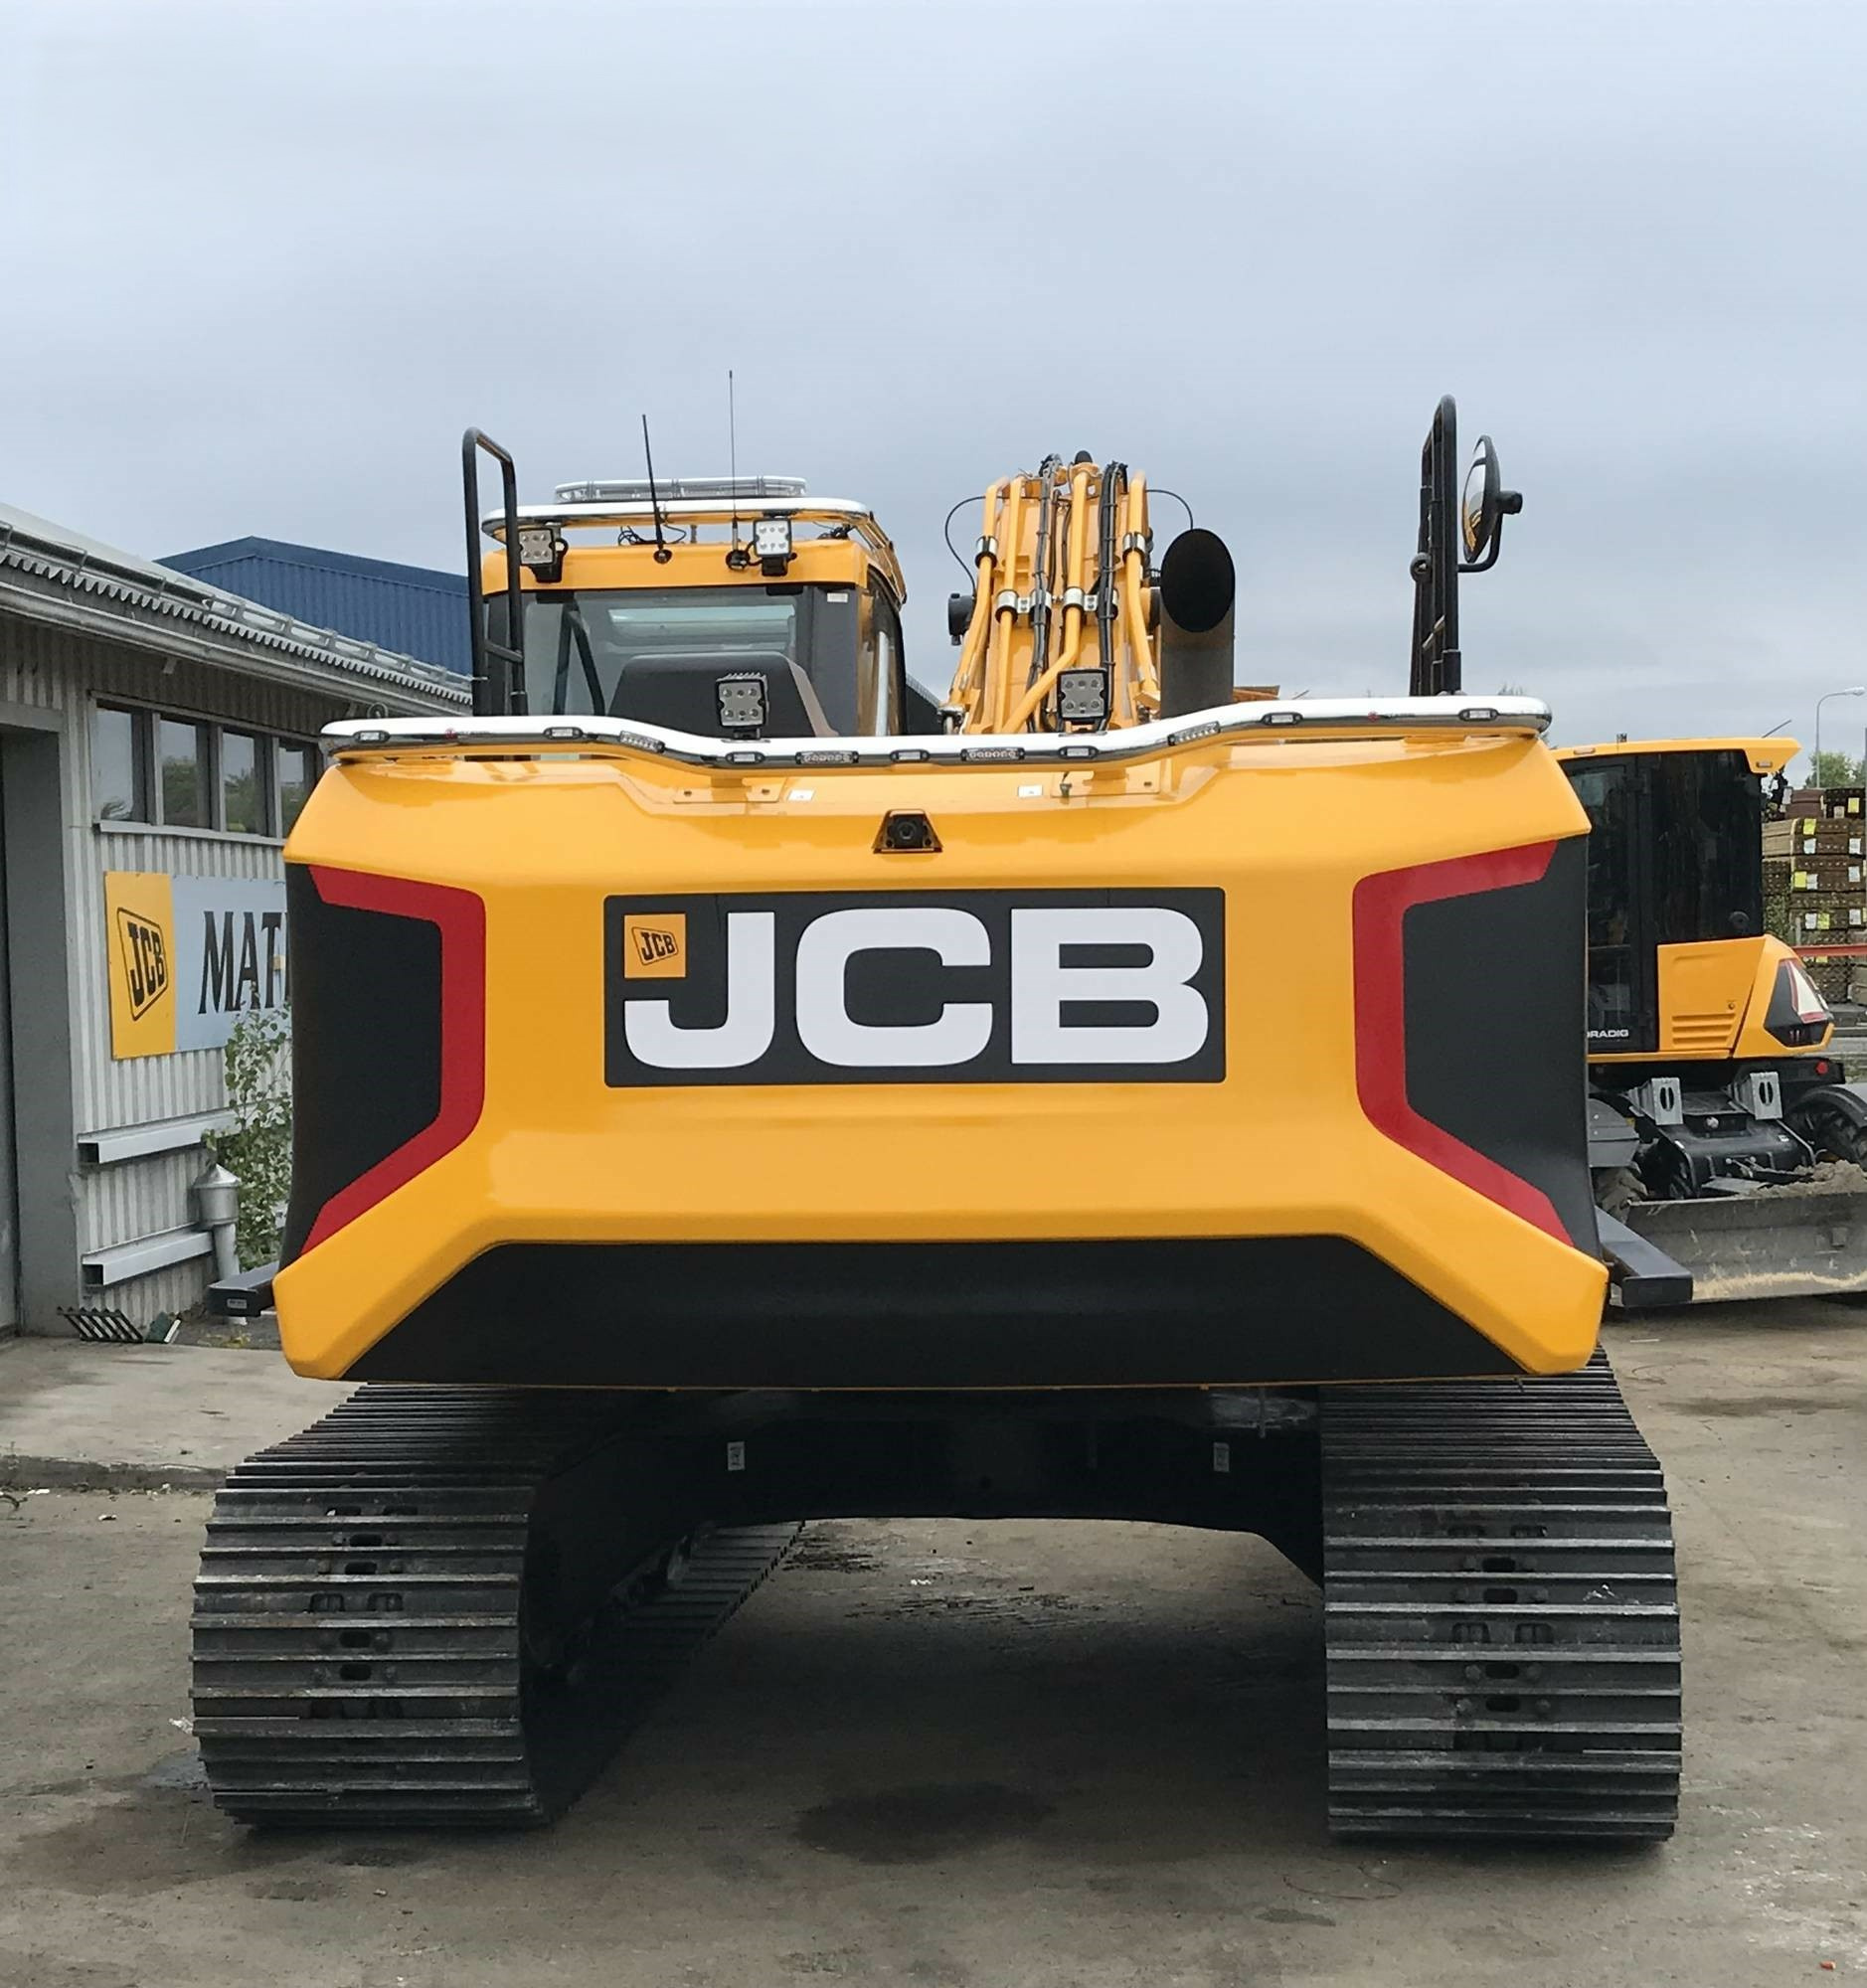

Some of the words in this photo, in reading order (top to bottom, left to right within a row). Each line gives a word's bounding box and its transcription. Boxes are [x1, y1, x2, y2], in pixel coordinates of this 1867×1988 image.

[126, 920, 166, 1008] JCB
[198, 911, 291, 1015] MAT
[623, 907, 1209, 1069] JCB
[640, 930, 676, 961] JCB
